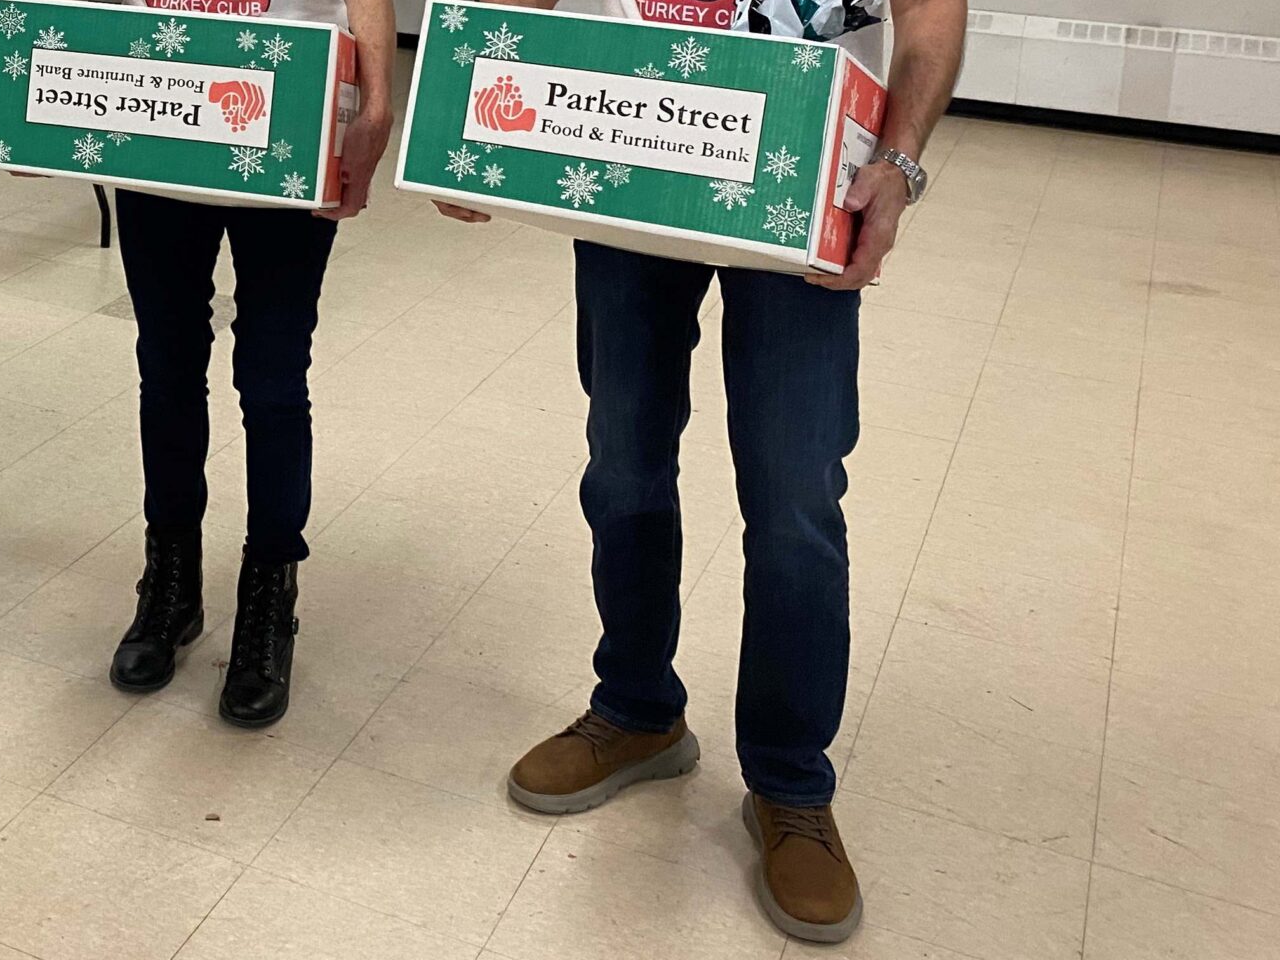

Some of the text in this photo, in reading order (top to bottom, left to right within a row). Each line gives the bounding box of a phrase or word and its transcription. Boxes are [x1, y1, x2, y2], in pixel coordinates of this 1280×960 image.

[217, 1, 262, 17] CLUB
[637, 0, 709, 23] TURKEY
[35, 64, 205, 94] Food & Furniture Bank
[35, 88, 202, 127] Parker Street
[545, 81, 752, 134] Parker Street
[539, 118, 750, 163] Food & Furniture Bank
